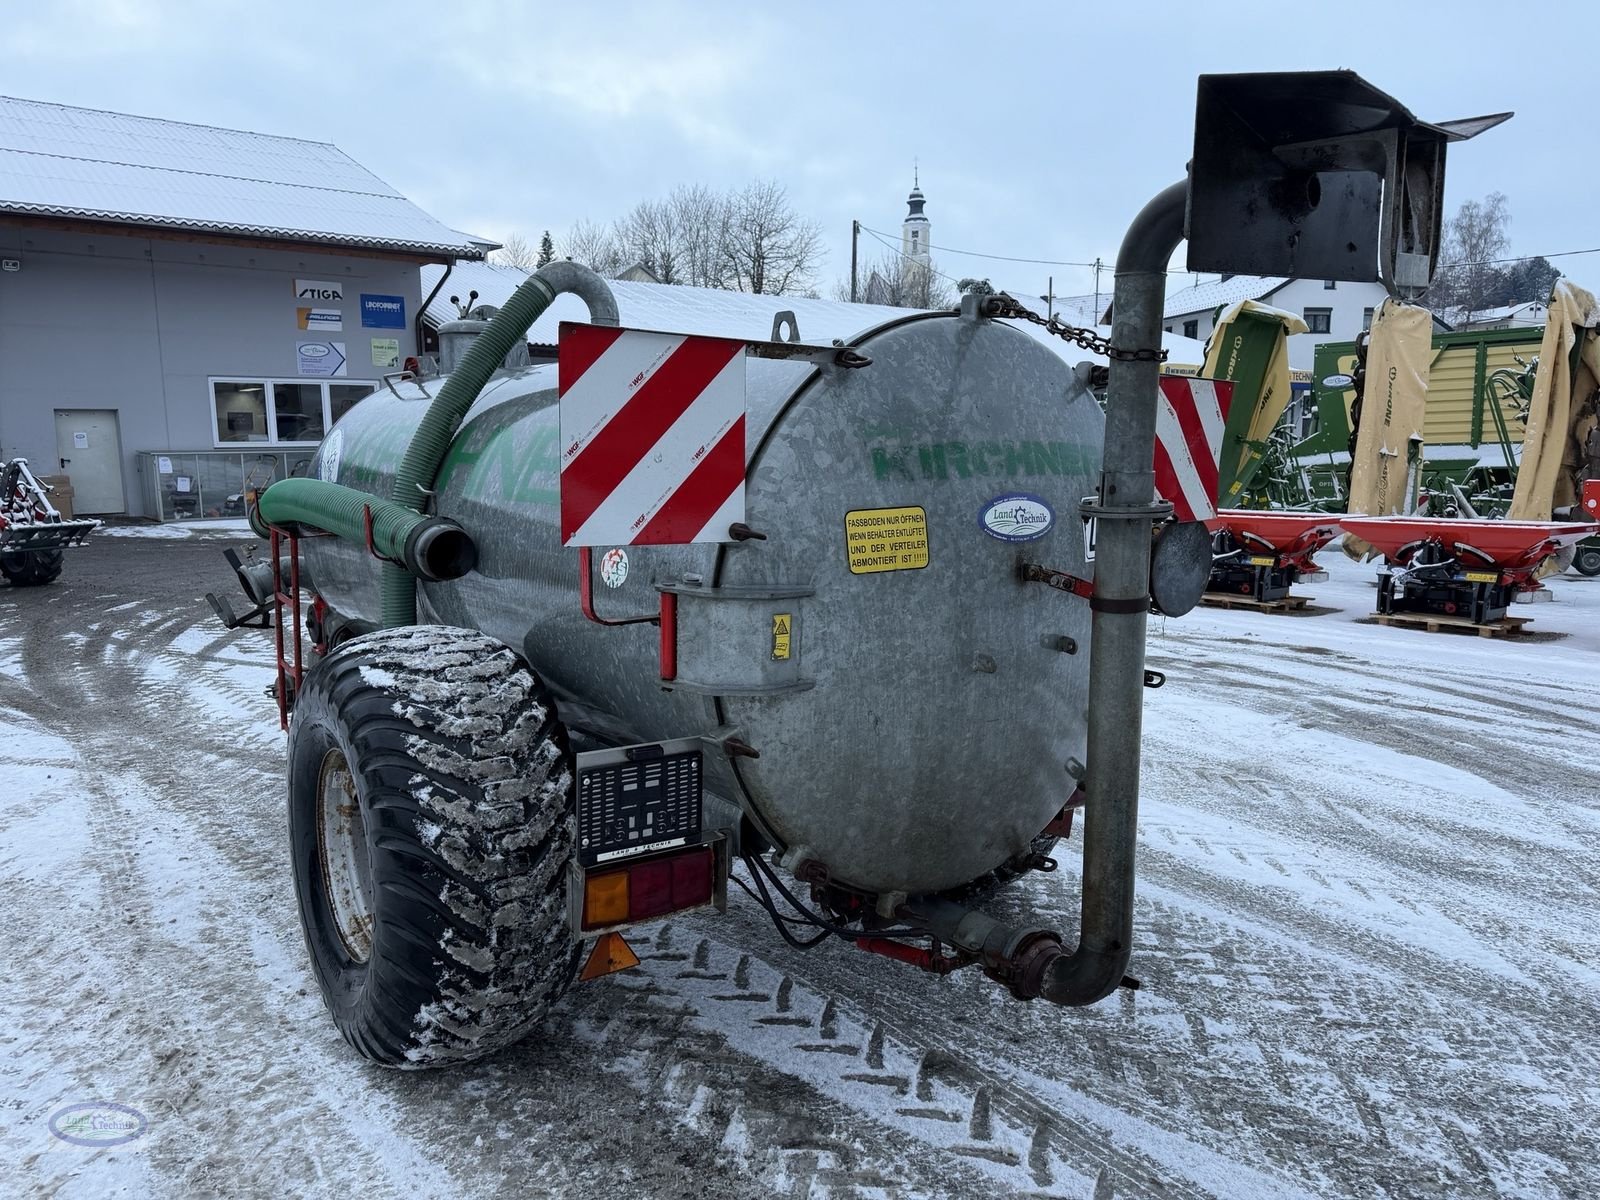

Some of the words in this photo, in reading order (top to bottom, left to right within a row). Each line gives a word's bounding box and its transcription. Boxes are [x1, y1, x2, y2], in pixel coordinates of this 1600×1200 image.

[299, 289, 342, 300] STIGA
[1226, 349, 1238, 380] KRON
[632, 371, 645, 386] WGF
[1292, 371, 1313, 381] TECHN
[566, 441, 580, 456] WGF
[694, 445, 706, 459] WGF
[633, 513, 646, 528] WGF
[848, 517, 886, 528] FASSBODEN
[886, 516, 900, 525] NUR
[900, 514, 924, 524] ÖFFNEN
[994, 508, 1014, 520] Land
[1020, 513, 1048, 524] Technik
[849, 532, 866, 541] WENN
[867, 529, 896, 540] BEHÄLTER
[896, 527, 925, 538] ENTLÜFTET
[850, 545, 867, 555] UND
[871, 543, 886, 553] DER
[889, 540, 927, 551] VERTEILER
[852, 556, 897, 568] ABMONTIERT
[901, 554, 912, 563] IST
[643, 840, 671, 849] TECHNIK
